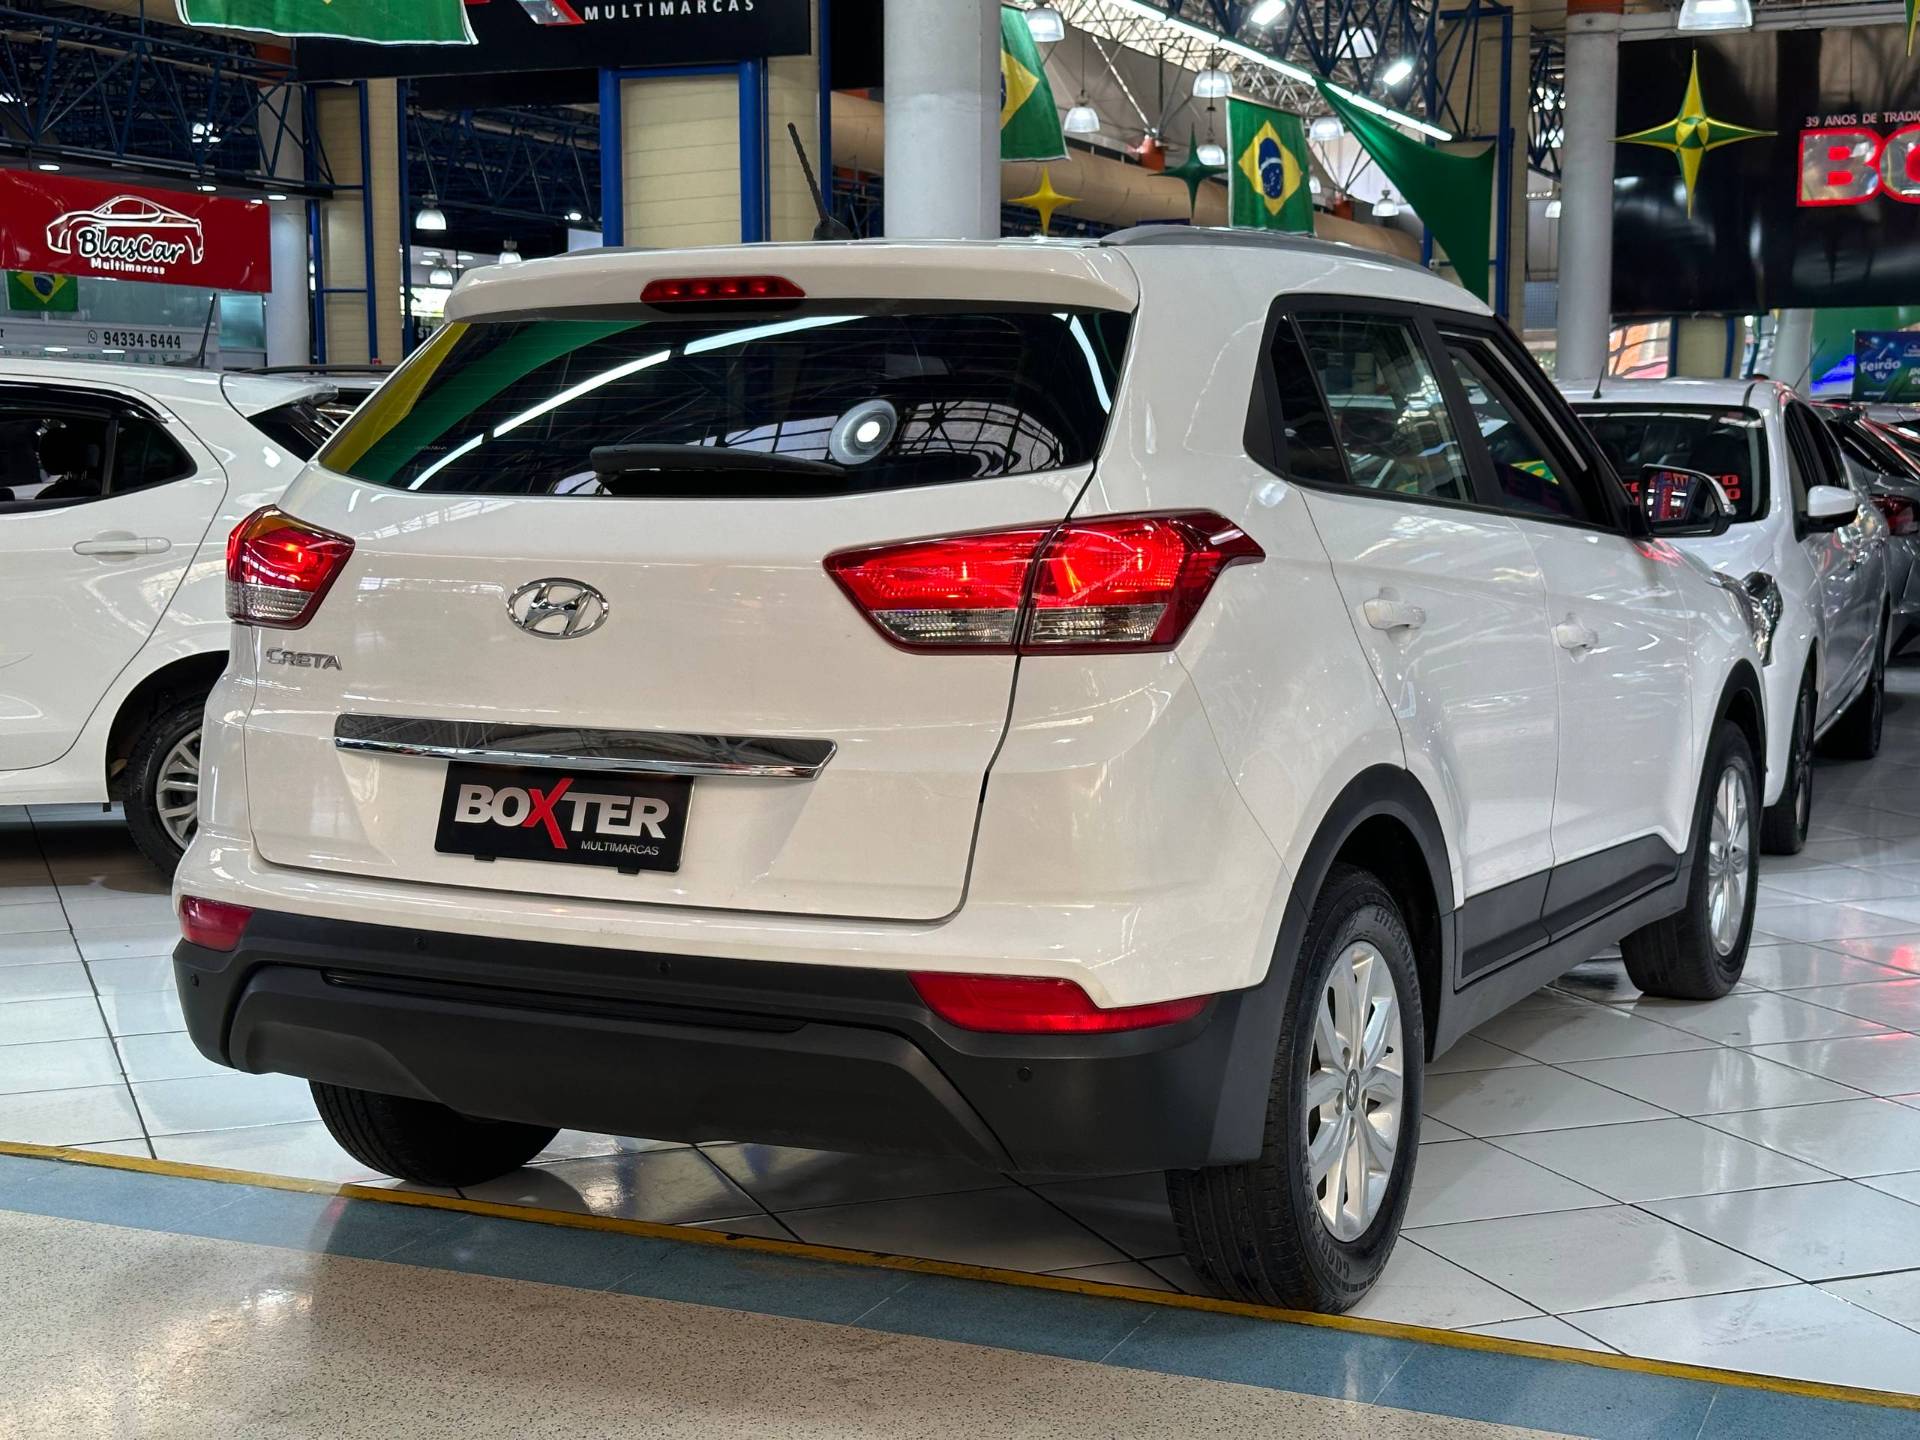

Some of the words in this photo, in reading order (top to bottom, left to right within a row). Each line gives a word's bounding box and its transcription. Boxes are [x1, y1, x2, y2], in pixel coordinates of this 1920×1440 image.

[584, 0, 754, 20] MULTIMARCAS
[1805, 116, 1820, 127] 39
[1824, 114, 1857, 126] ANOS
[1862, 112, 1878, 124] DE
[77, 226, 186, 264] BlasCar
[90, 257, 166, 275] Multimarcas
[103, 331, 181, 349] 94334-6444
[266, 647, 343, 671] CRETA
[454, 777, 670, 850] BOXTER
[581, 840, 660, 856] MULTIMARCAS
